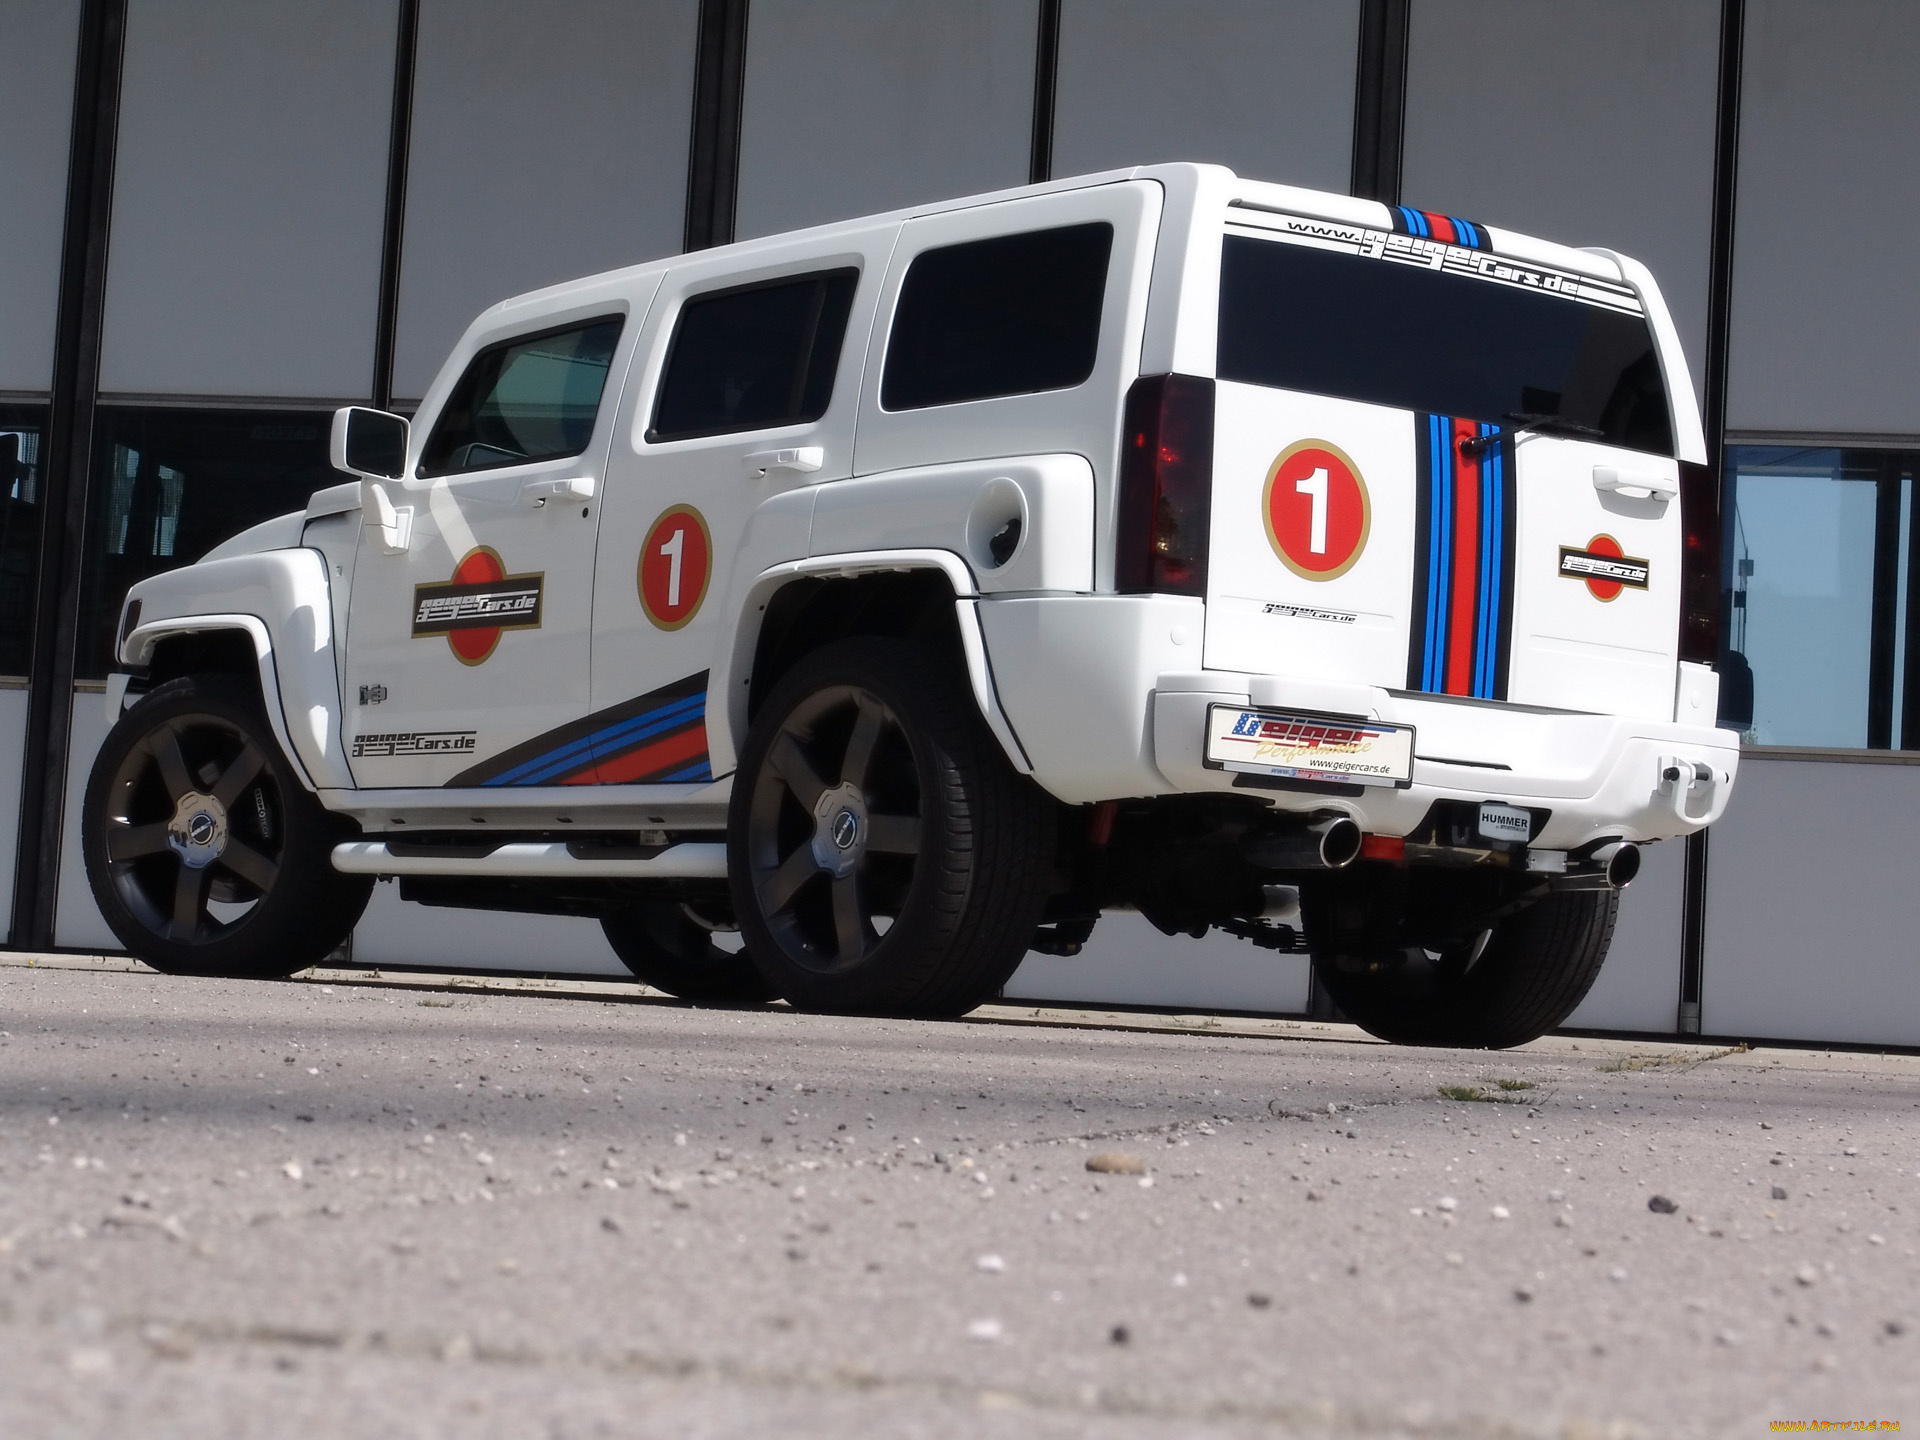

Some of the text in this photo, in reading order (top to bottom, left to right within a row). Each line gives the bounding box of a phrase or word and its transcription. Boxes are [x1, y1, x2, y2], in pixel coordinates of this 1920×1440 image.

[1296, 467, 1328, 554] 1
[660, 529, 684, 606] 1
[352, 731, 477, 757] geigerCars.de
[1310, 759, 1390, 775] www.geigercars.de
[1481, 813, 1528, 828] HUMMER
